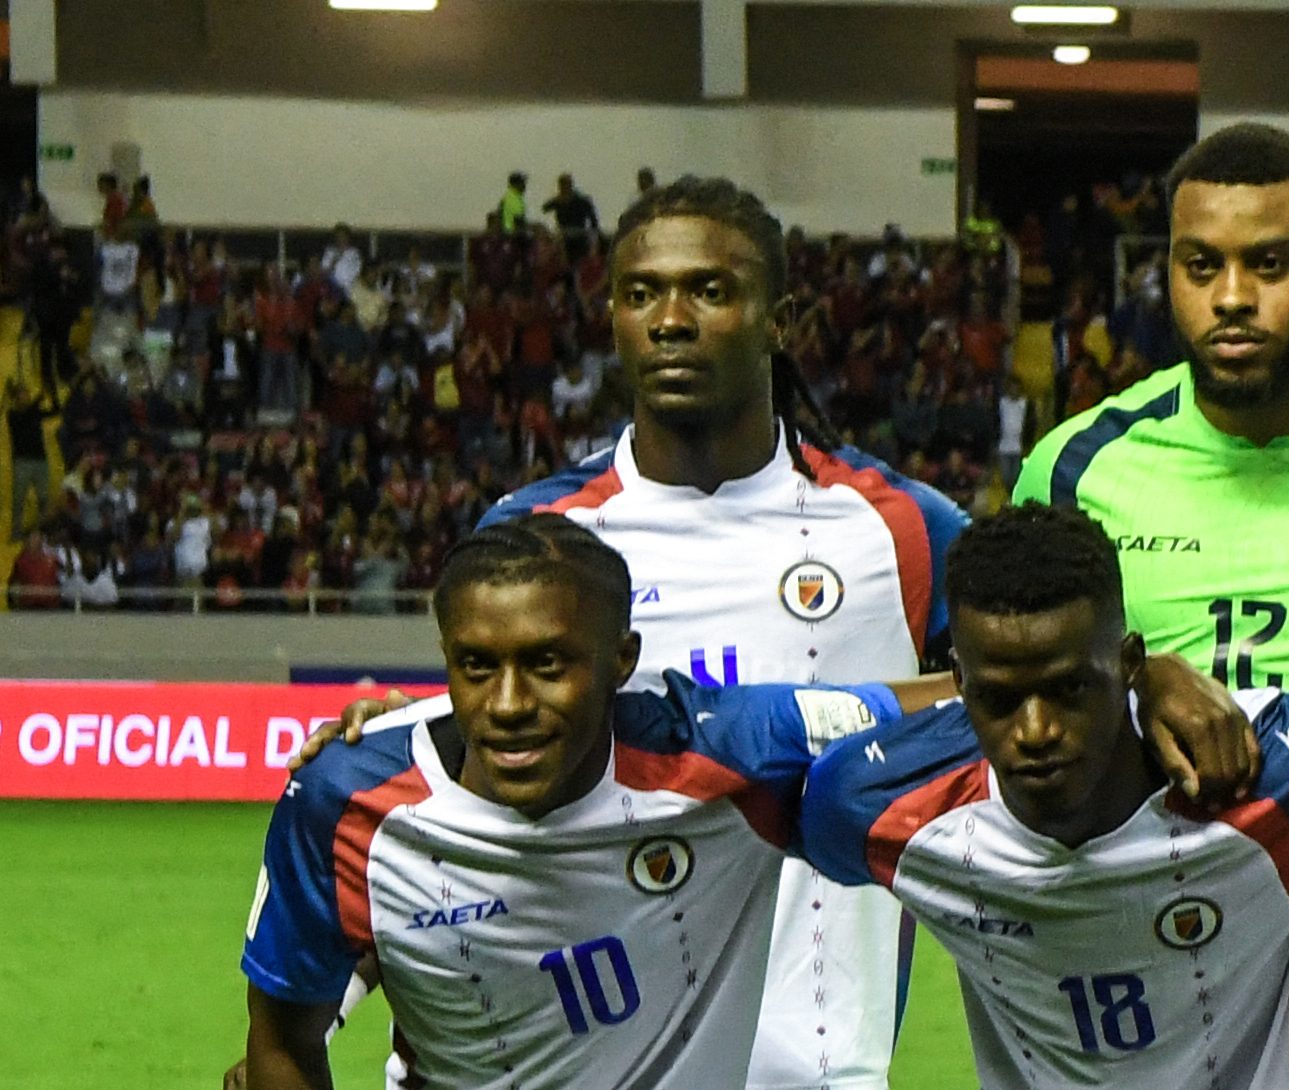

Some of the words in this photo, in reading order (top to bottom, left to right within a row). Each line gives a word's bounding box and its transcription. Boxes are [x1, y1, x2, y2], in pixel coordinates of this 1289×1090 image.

[1116, 535, 1200, 553] SAETA
[1208, 599, 1288, 690] 12
[18, 713, 248, 767] OFICIAL
[406, 899, 509, 930] SAETA
[538, 935, 641, 1034] 10
[1058, 973, 1156, 1051] 18
